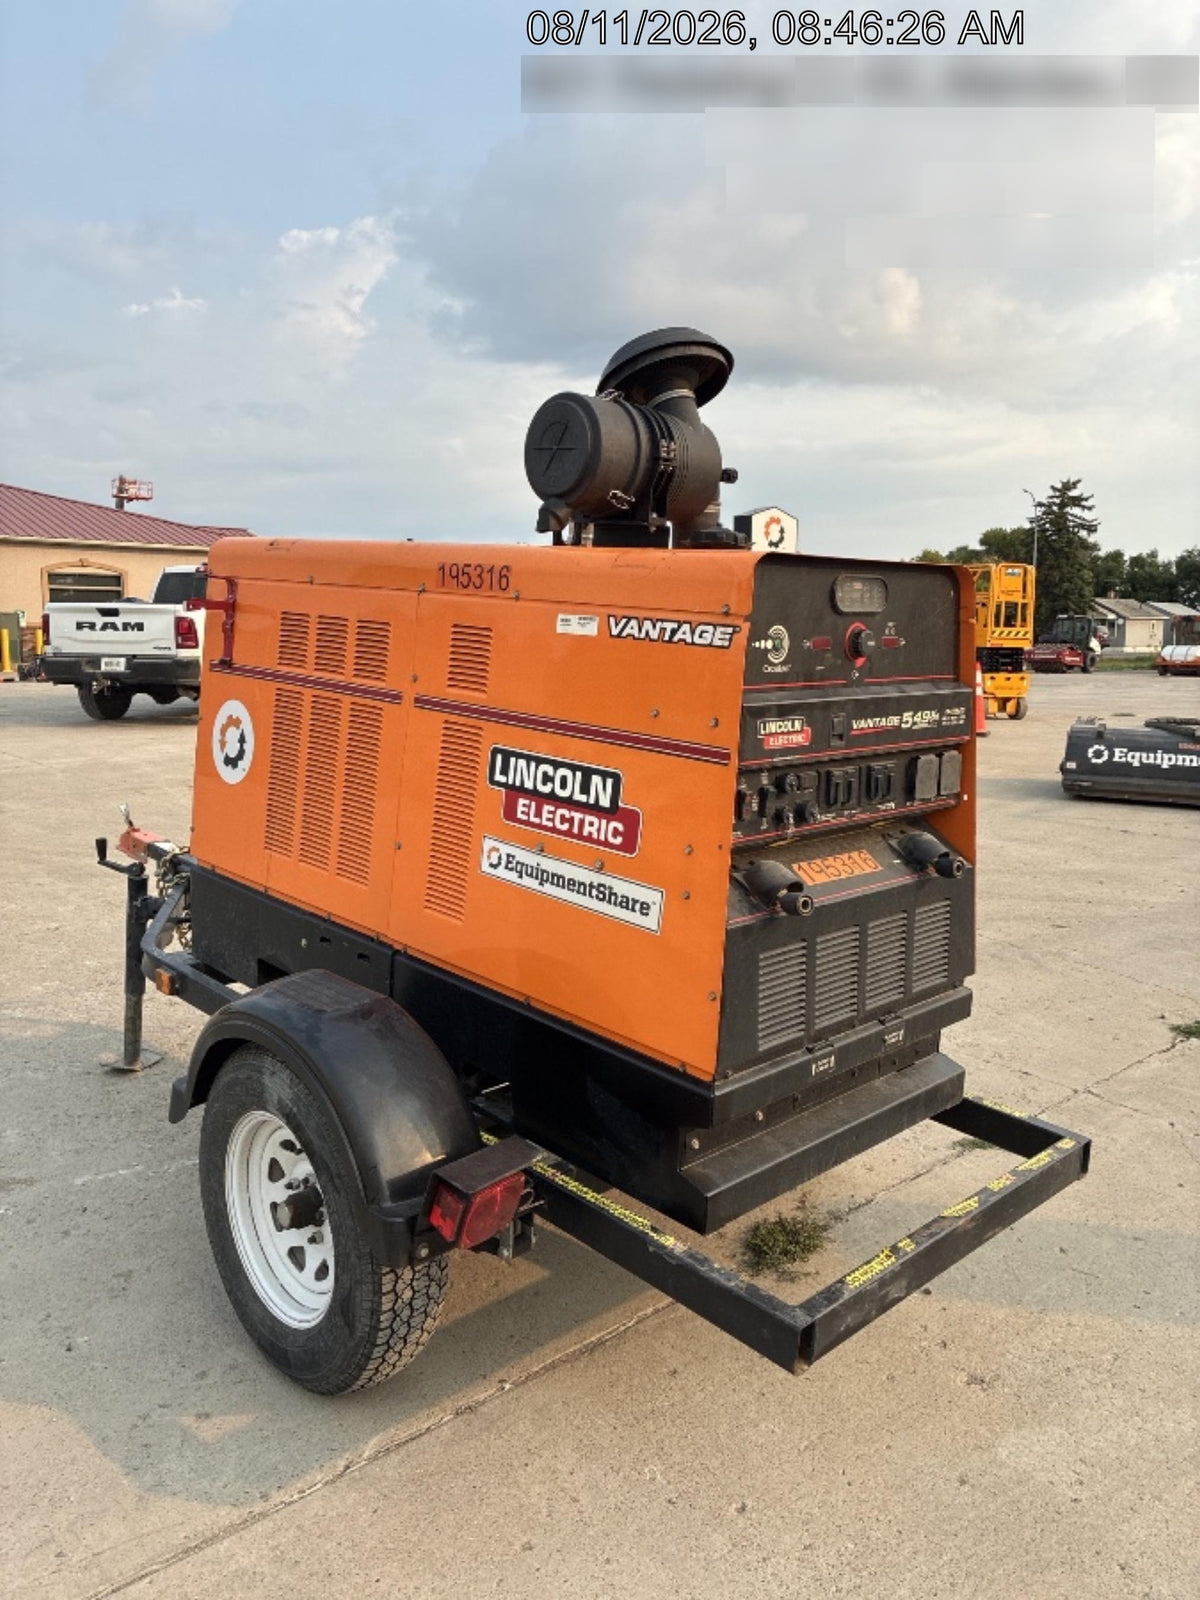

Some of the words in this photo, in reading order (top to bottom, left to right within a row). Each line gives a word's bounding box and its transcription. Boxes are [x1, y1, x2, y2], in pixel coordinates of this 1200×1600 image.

[437, 563, 510, 591] 195316
[76, 622, 144, 631] RAM
[608, 615, 734, 647] VANTAGE
[760, 719, 802, 734] LINCOLN
[851, 716, 901, 729] VANTAGE
[1113, 748, 1200, 769] Equipm
[493, 753, 614, 809] LINCOLN
[516, 798, 625, 846] ELECTRIC
[796, 850, 880, 882] 195316
[503, 851, 652, 918] EquipmentShare
